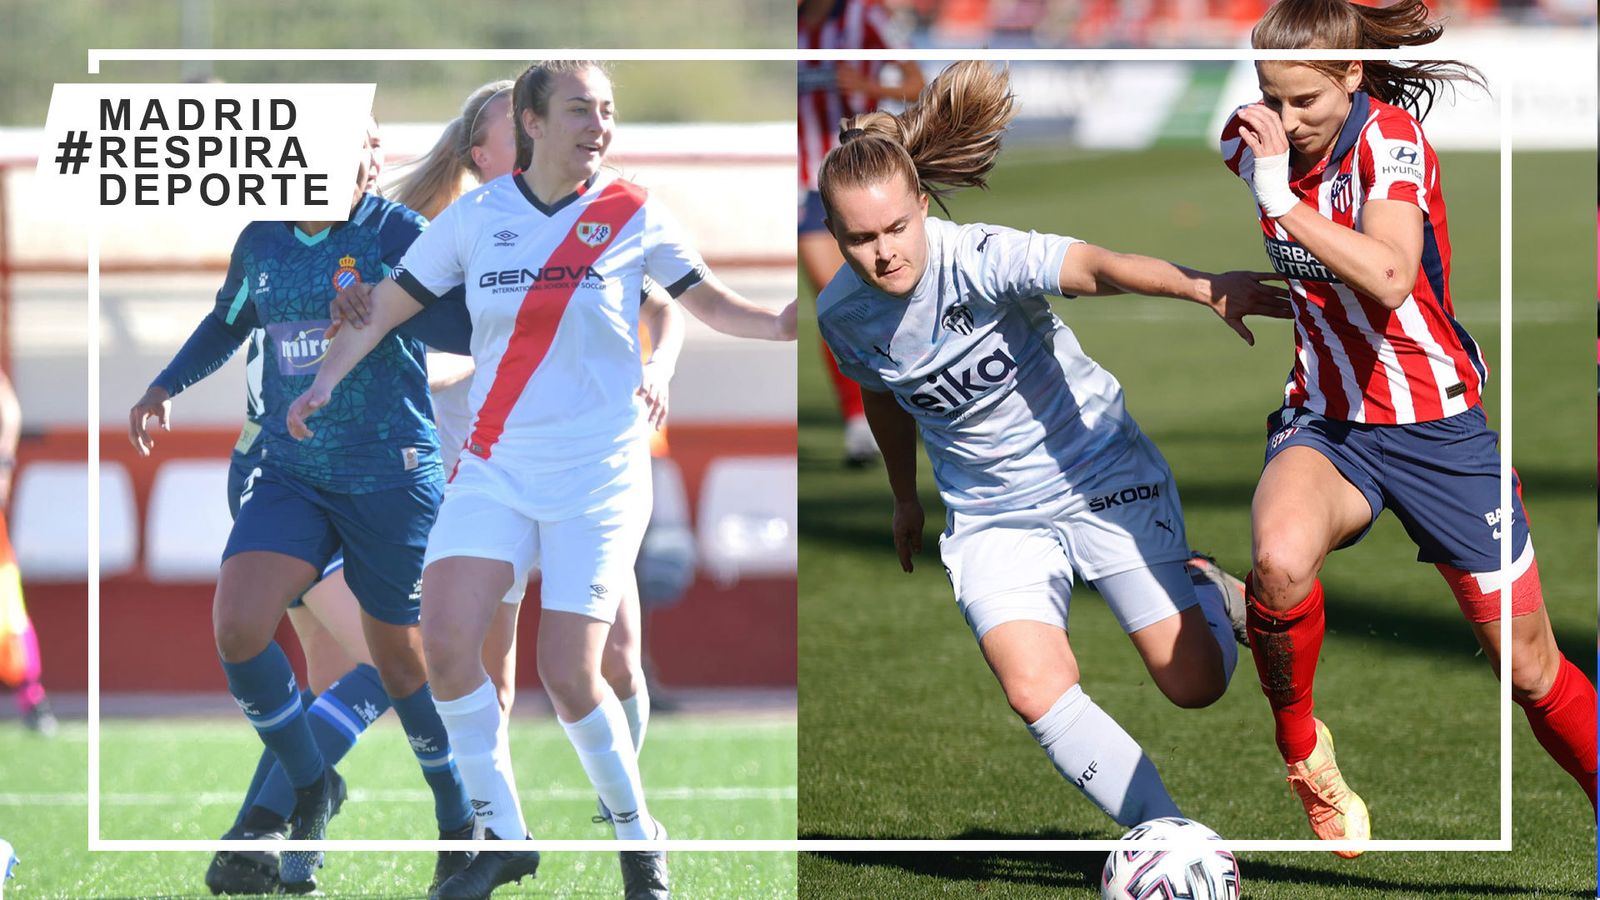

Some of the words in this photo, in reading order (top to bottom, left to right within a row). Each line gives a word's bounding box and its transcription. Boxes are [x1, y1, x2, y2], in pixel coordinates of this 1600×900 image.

[1382, 165, 1422, 182] HYUNDA
[1264, 240, 1320, 264] HERBA
[479, 265, 605, 288] GENOVA
[581, 281, 606, 291] SOCCER
[909, 347, 1018, 413] eika
[1074, 760, 1099, 789] VCF
